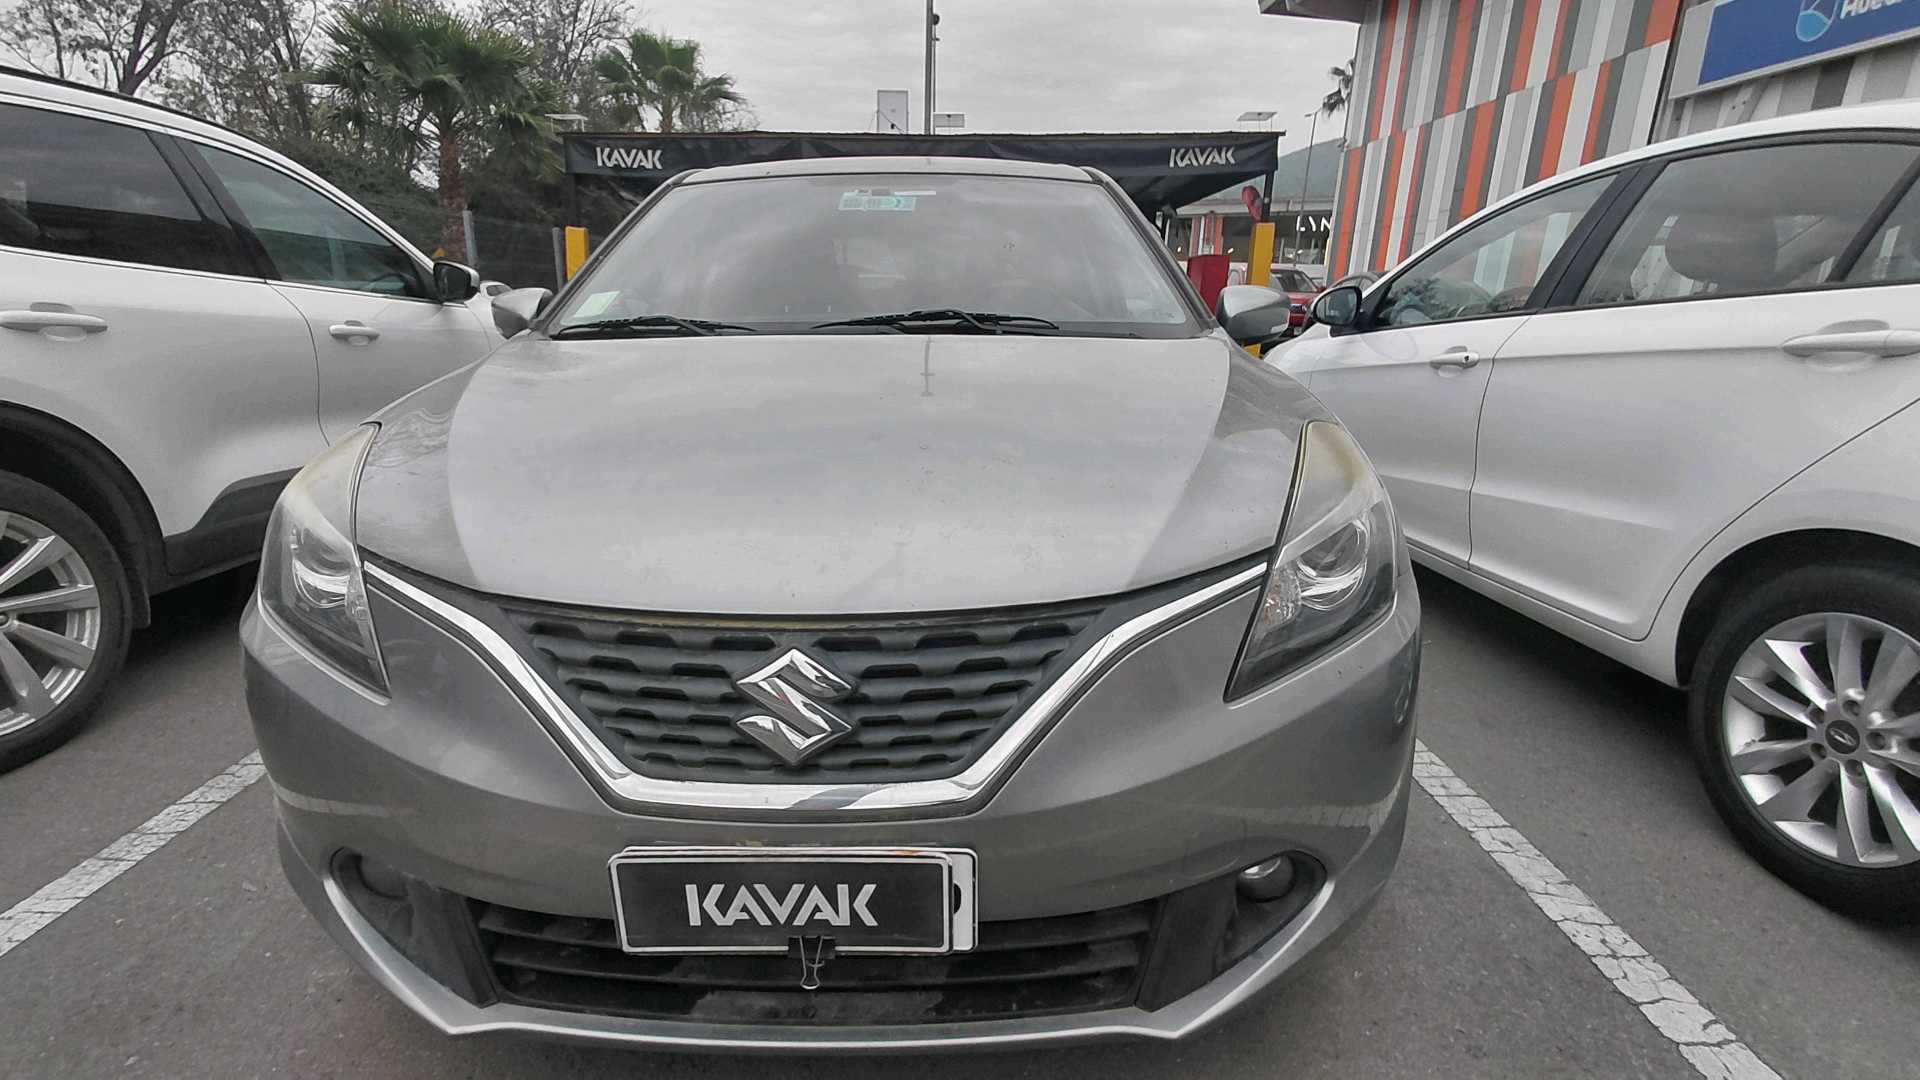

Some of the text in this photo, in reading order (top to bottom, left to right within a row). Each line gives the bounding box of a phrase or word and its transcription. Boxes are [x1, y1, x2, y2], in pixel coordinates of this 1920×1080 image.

[595, 146, 663, 170] KAVAK
[1169, 146, 1235, 168] KAVAK
[684, 883, 879, 926] KAVAK
